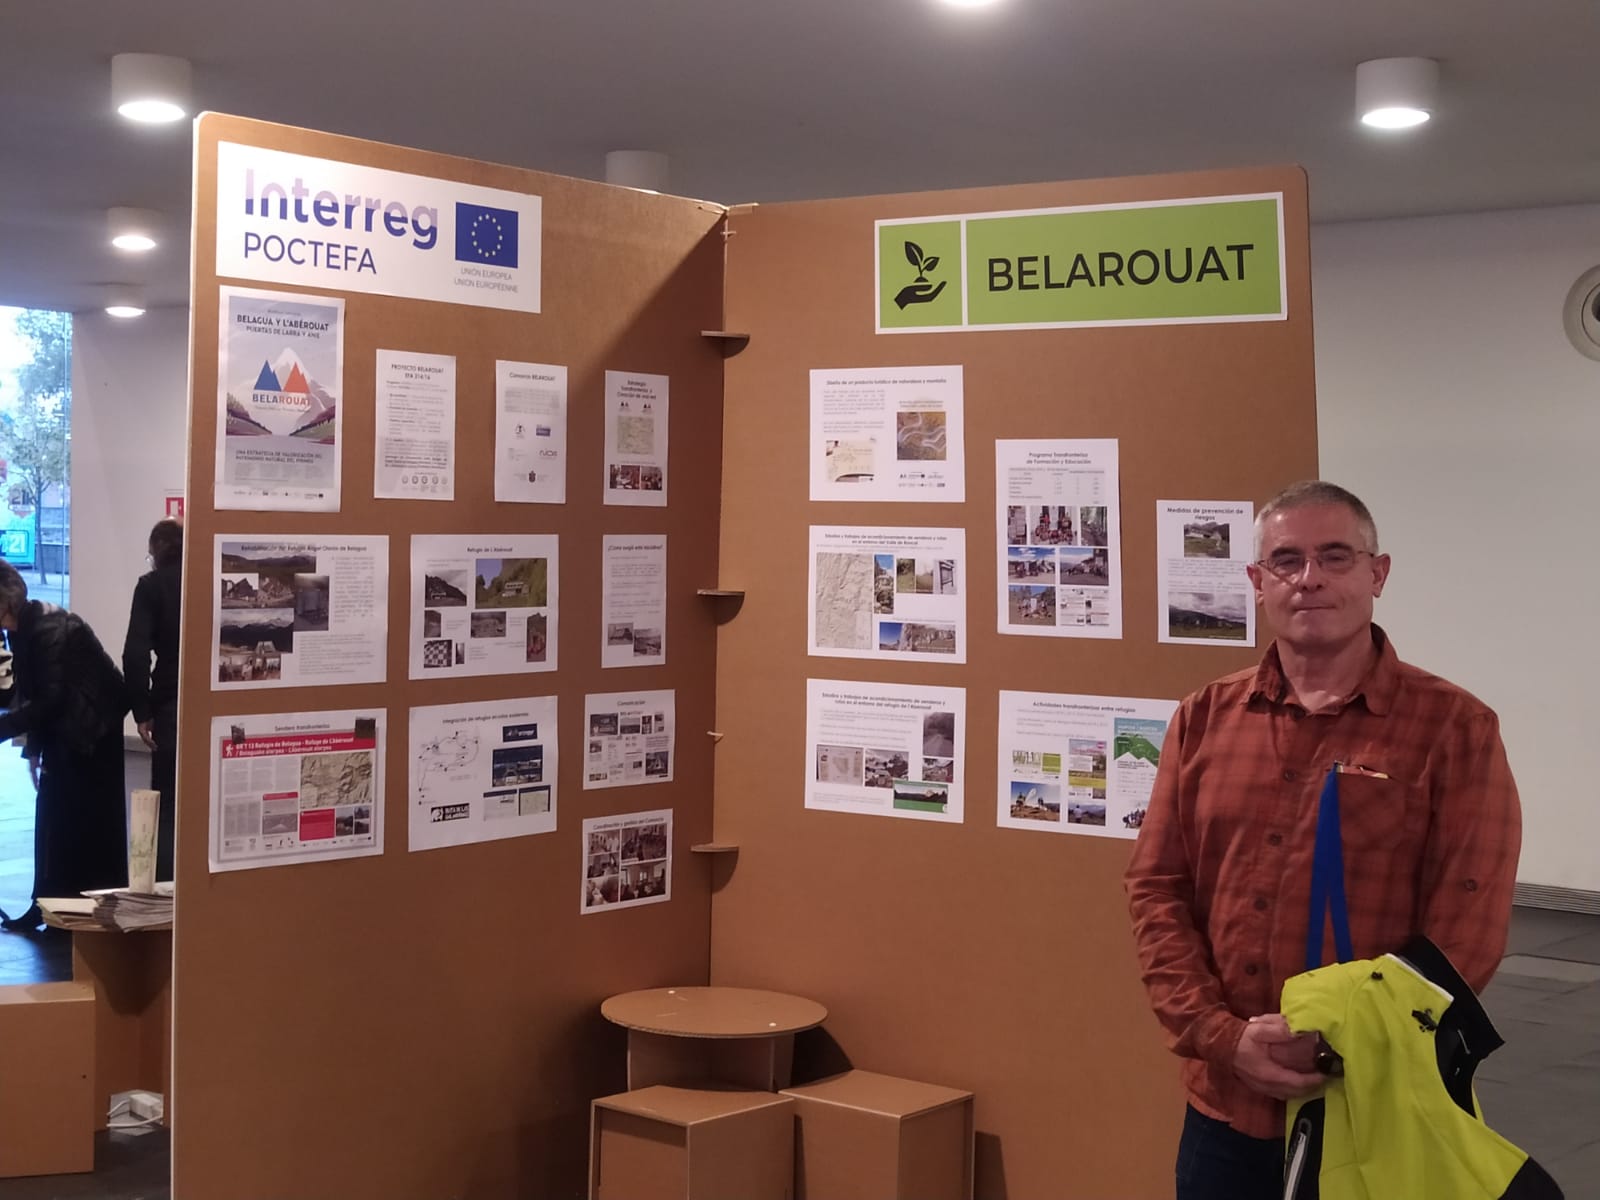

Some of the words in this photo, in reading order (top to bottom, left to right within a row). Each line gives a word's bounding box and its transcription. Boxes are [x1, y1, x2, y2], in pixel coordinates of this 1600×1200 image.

[244, 167, 438, 250] Interreg
[244, 231, 378, 275] POCTEFA
[482, 269, 513, 281] EUROPEA
[988, 244, 1255, 292] BELAROUAT
[236, 314, 273, 326] BELAGUA
[275, 318, 281, 326] Y
[246, 326, 272, 335] PUERTAS
[273, 328, 281, 336] DE
[281, 329, 300, 337] LARRA
[252, 393, 311, 407] BELAROUAT
